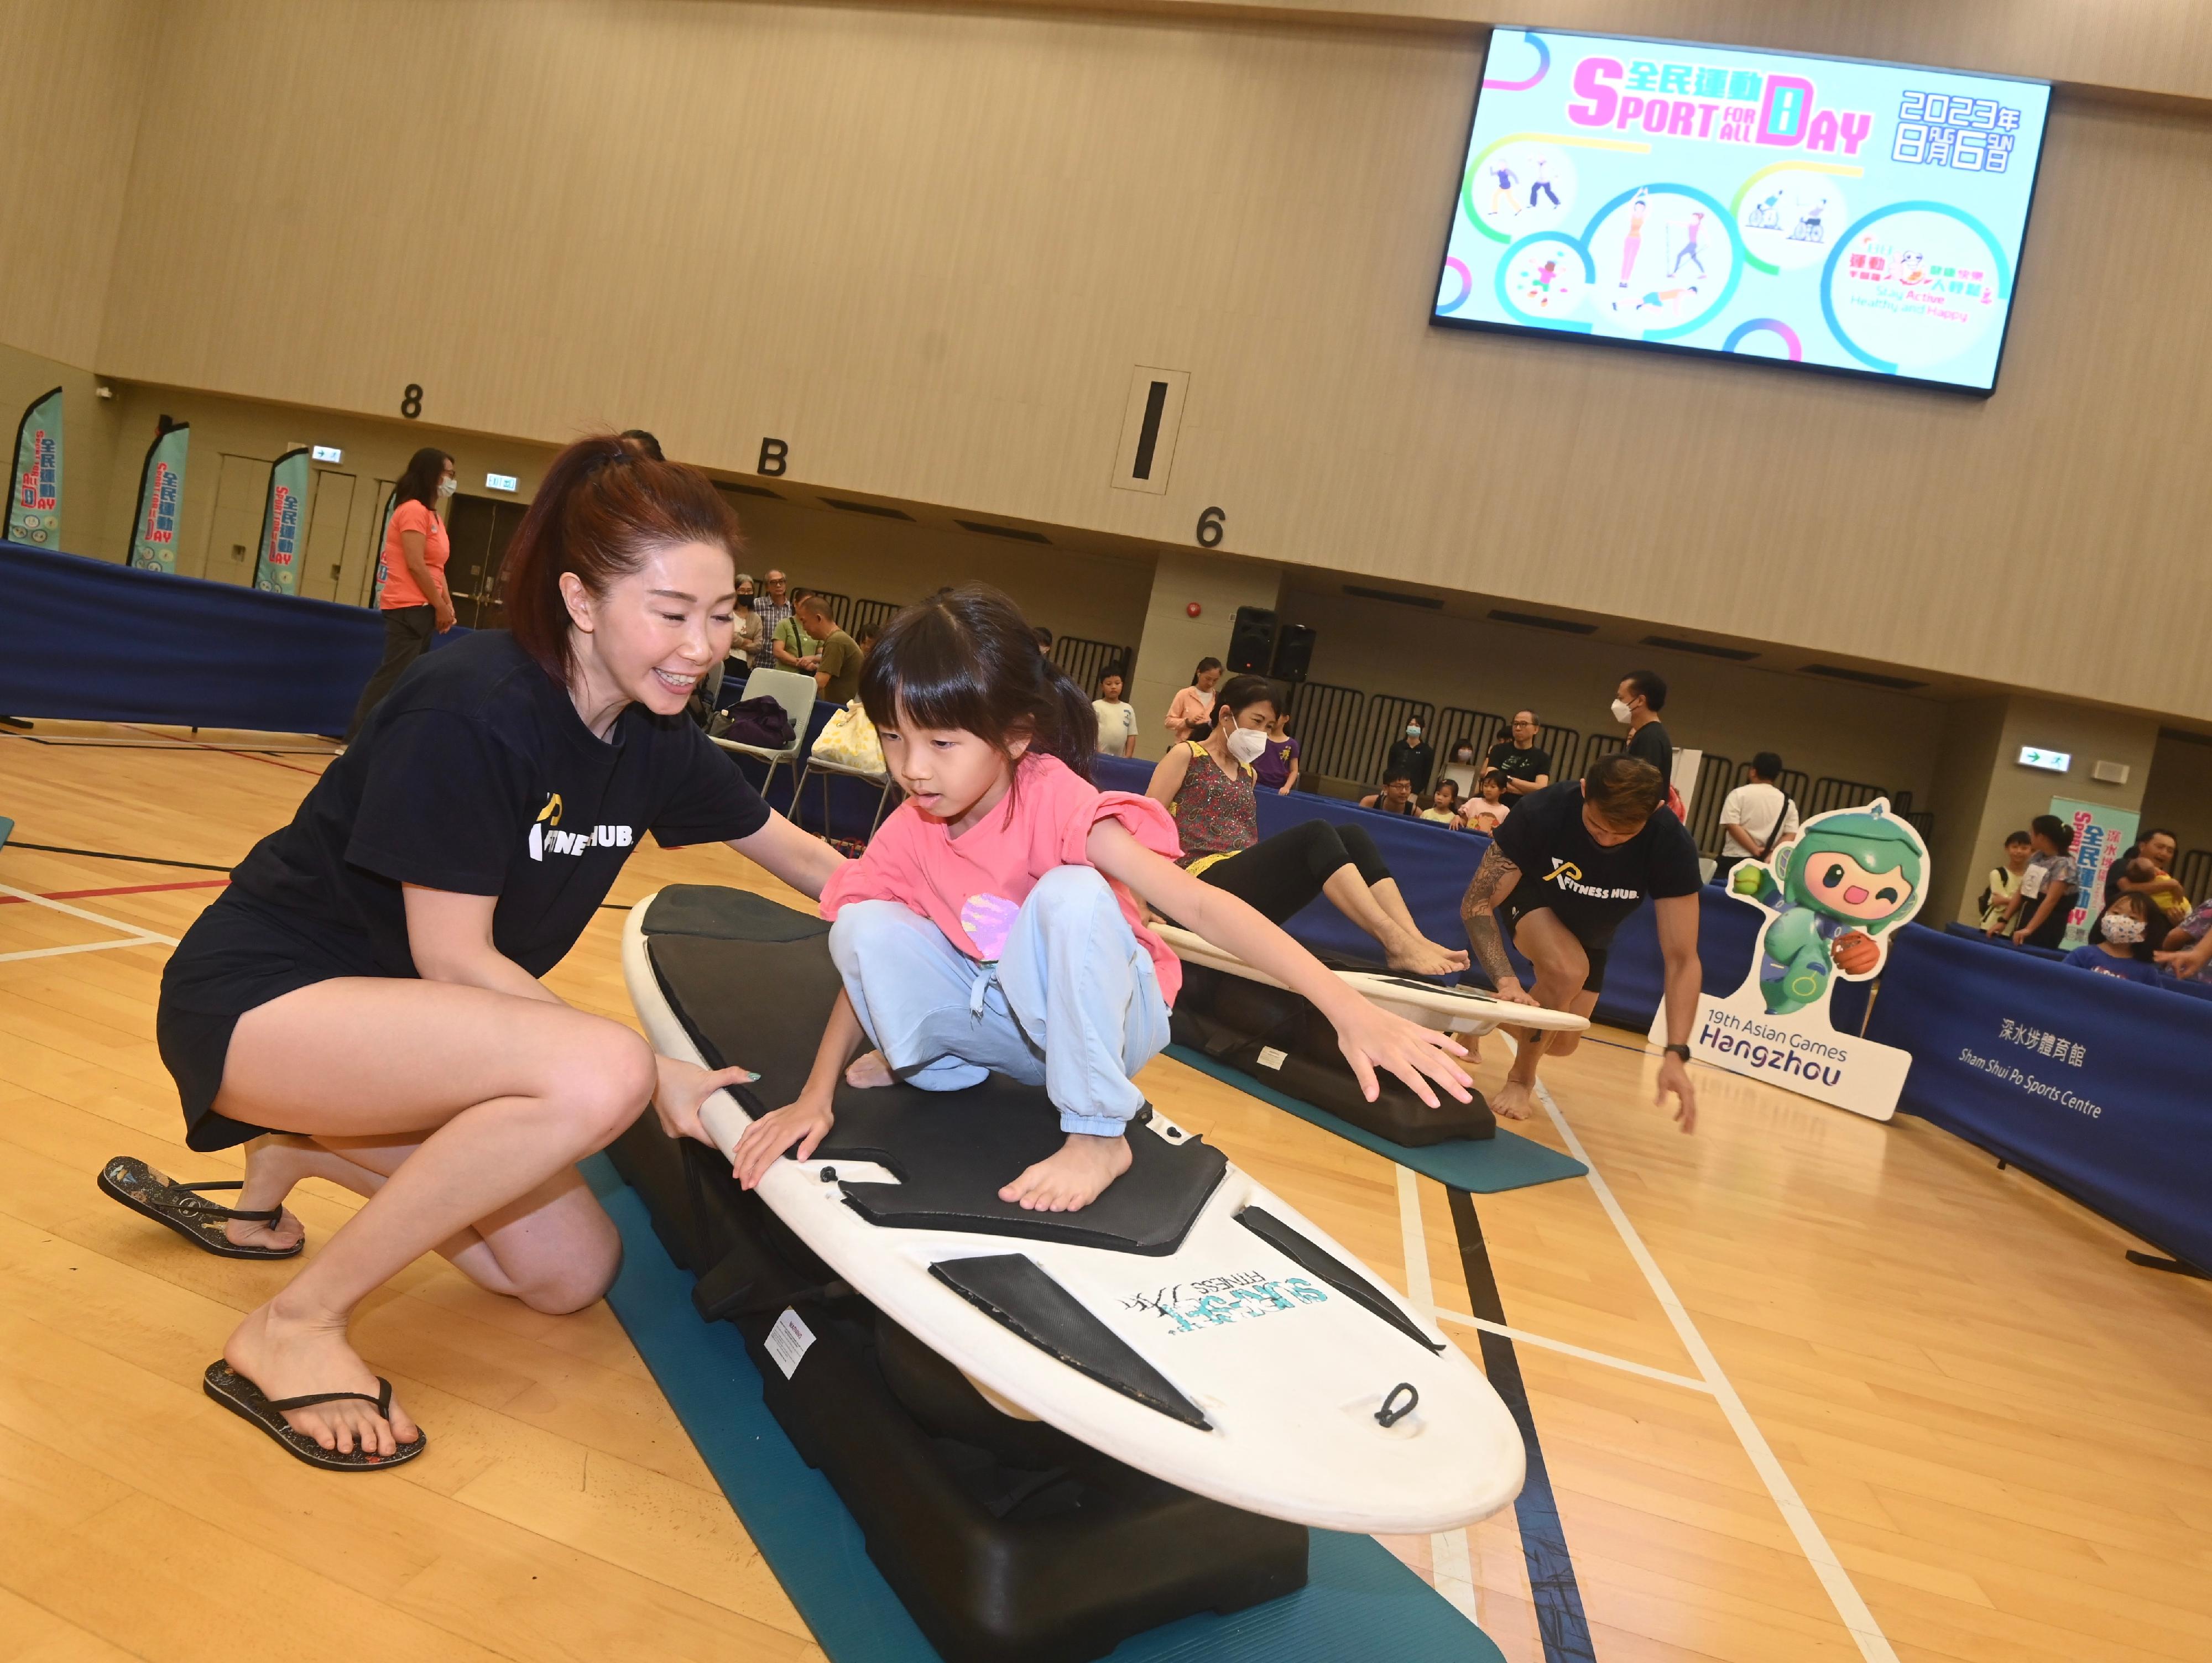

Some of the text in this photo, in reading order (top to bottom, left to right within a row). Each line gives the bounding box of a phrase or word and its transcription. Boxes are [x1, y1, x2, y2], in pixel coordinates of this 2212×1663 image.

[1625, 60, 1762, 102] 全民運動
[1568, 57, 1871, 155] SPORT FOR ALL DAY
[1987, 133, 2015, 153] SUN
[1850, 295, 1968, 323] Healthy and Happy
[1906, 290, 1945, 305] Active
[401, 383, 424, 420] 8
[757, 437, 789, 477] B
[21, 485, 56, 508] DAY
[1195, 505, 1226, 548] 6
[1564, 876, 1609, 899] FITNESS
[1708, 1009, 1848, 1062] 19th Asian Games
[1998, 1017, 2086, 1068] 深水埗體育館
[1699, 1024, 1841, 1087] Hangzhou
[1959, 1048, 2102, 1118] Sham Shui Po Sports Centre
[1191, 1270, 1266, 1294] FITNESS
[788, 1321, 802, 1340] WARNING
